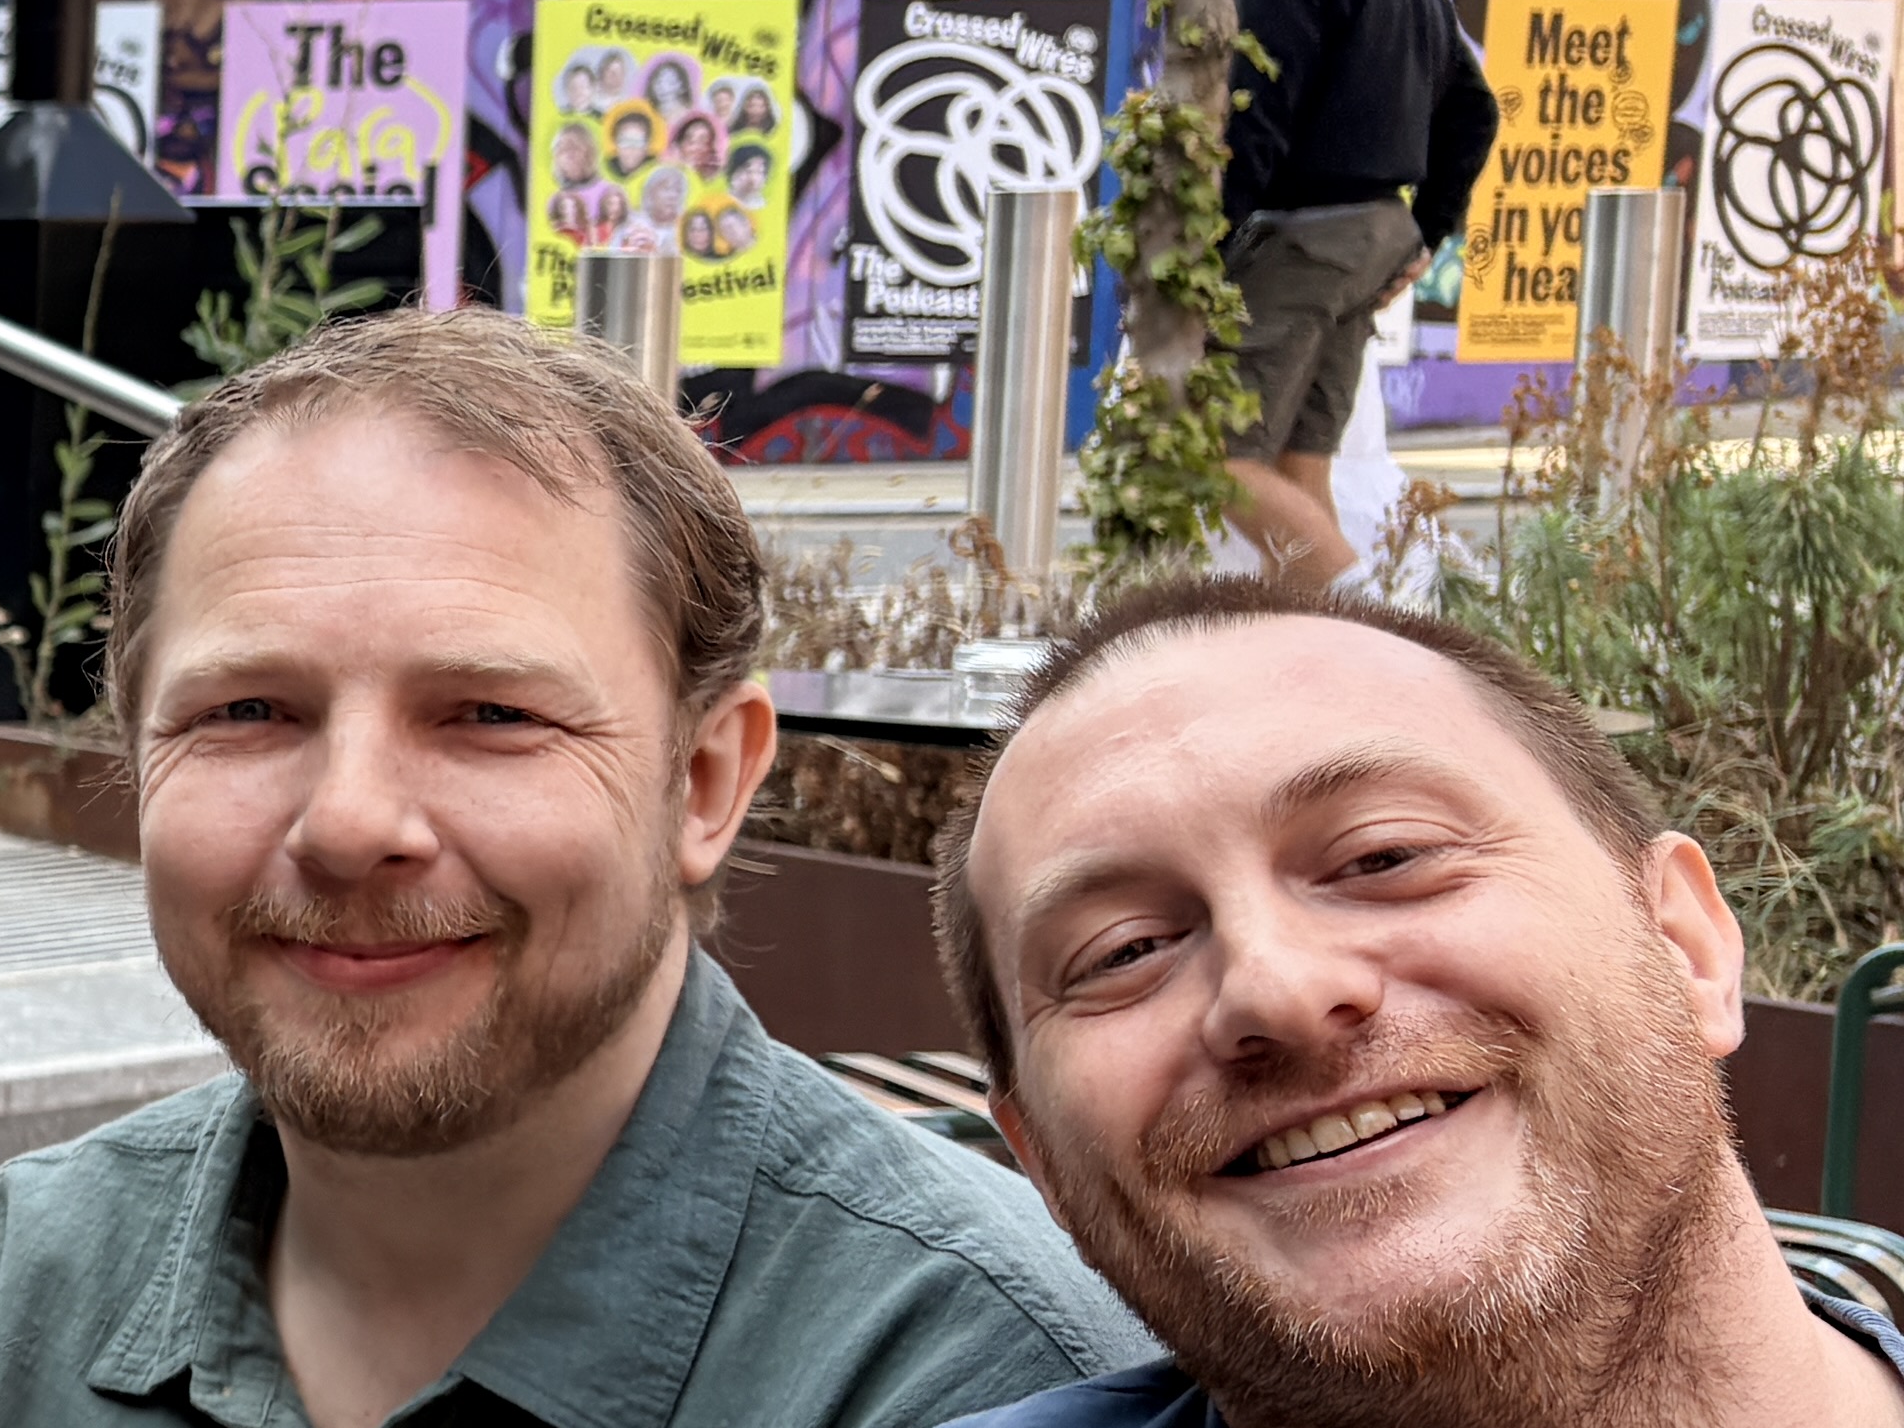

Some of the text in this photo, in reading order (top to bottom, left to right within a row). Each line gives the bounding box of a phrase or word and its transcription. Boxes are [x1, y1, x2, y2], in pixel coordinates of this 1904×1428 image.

[585, 3, 778, 80] Crossed Wires
[904, 0, 1095, 84] Crossed Wires
[1526, 6, 1630, 68] Meet
[1752, 3, 1832, 46] Crossed
[285, 22, 405, 89] The
[1538, 70, 1605, 126] the
[1499, 129, 1632, 186] voices
[1492, 189, 1583, 258] in yo
[681, 258, 776, 304] estival
[851, 243, 905, 285] The
[1502, 249, 1578, 305] hea
